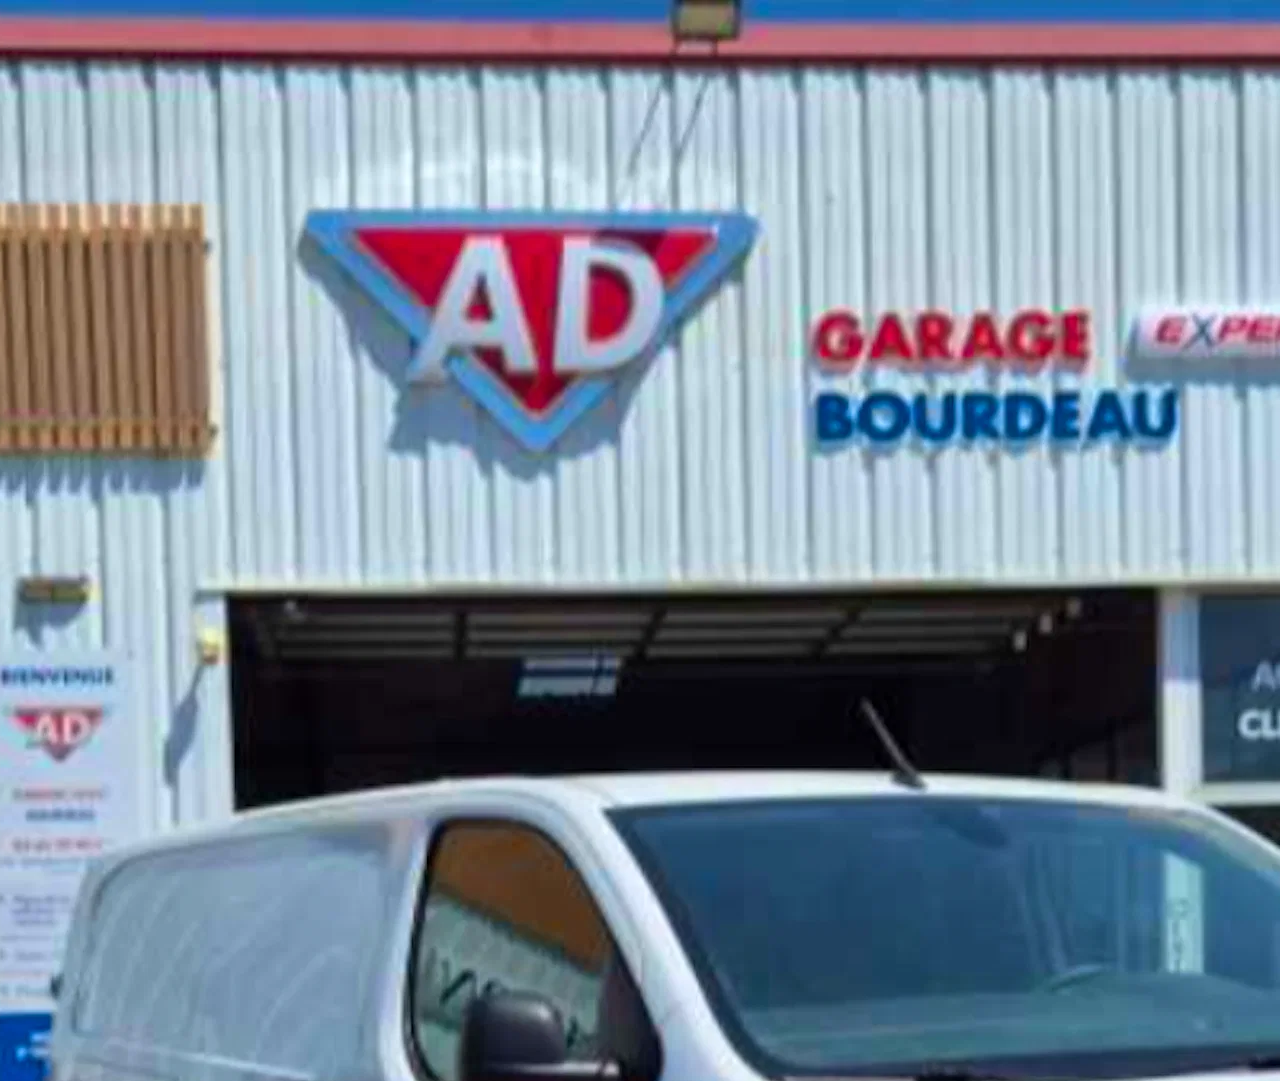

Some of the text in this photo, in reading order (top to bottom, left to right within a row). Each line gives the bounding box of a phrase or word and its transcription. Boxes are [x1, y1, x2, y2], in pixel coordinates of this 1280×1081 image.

[408, 236, 667, 378] AD
[813, 311, 1091, 364] GARAGE
[815, 389, 1180, 444] BOURDEAU
[0, 667, 114, 687] BIENVENUE
[28, 713, 91, 746] AD
